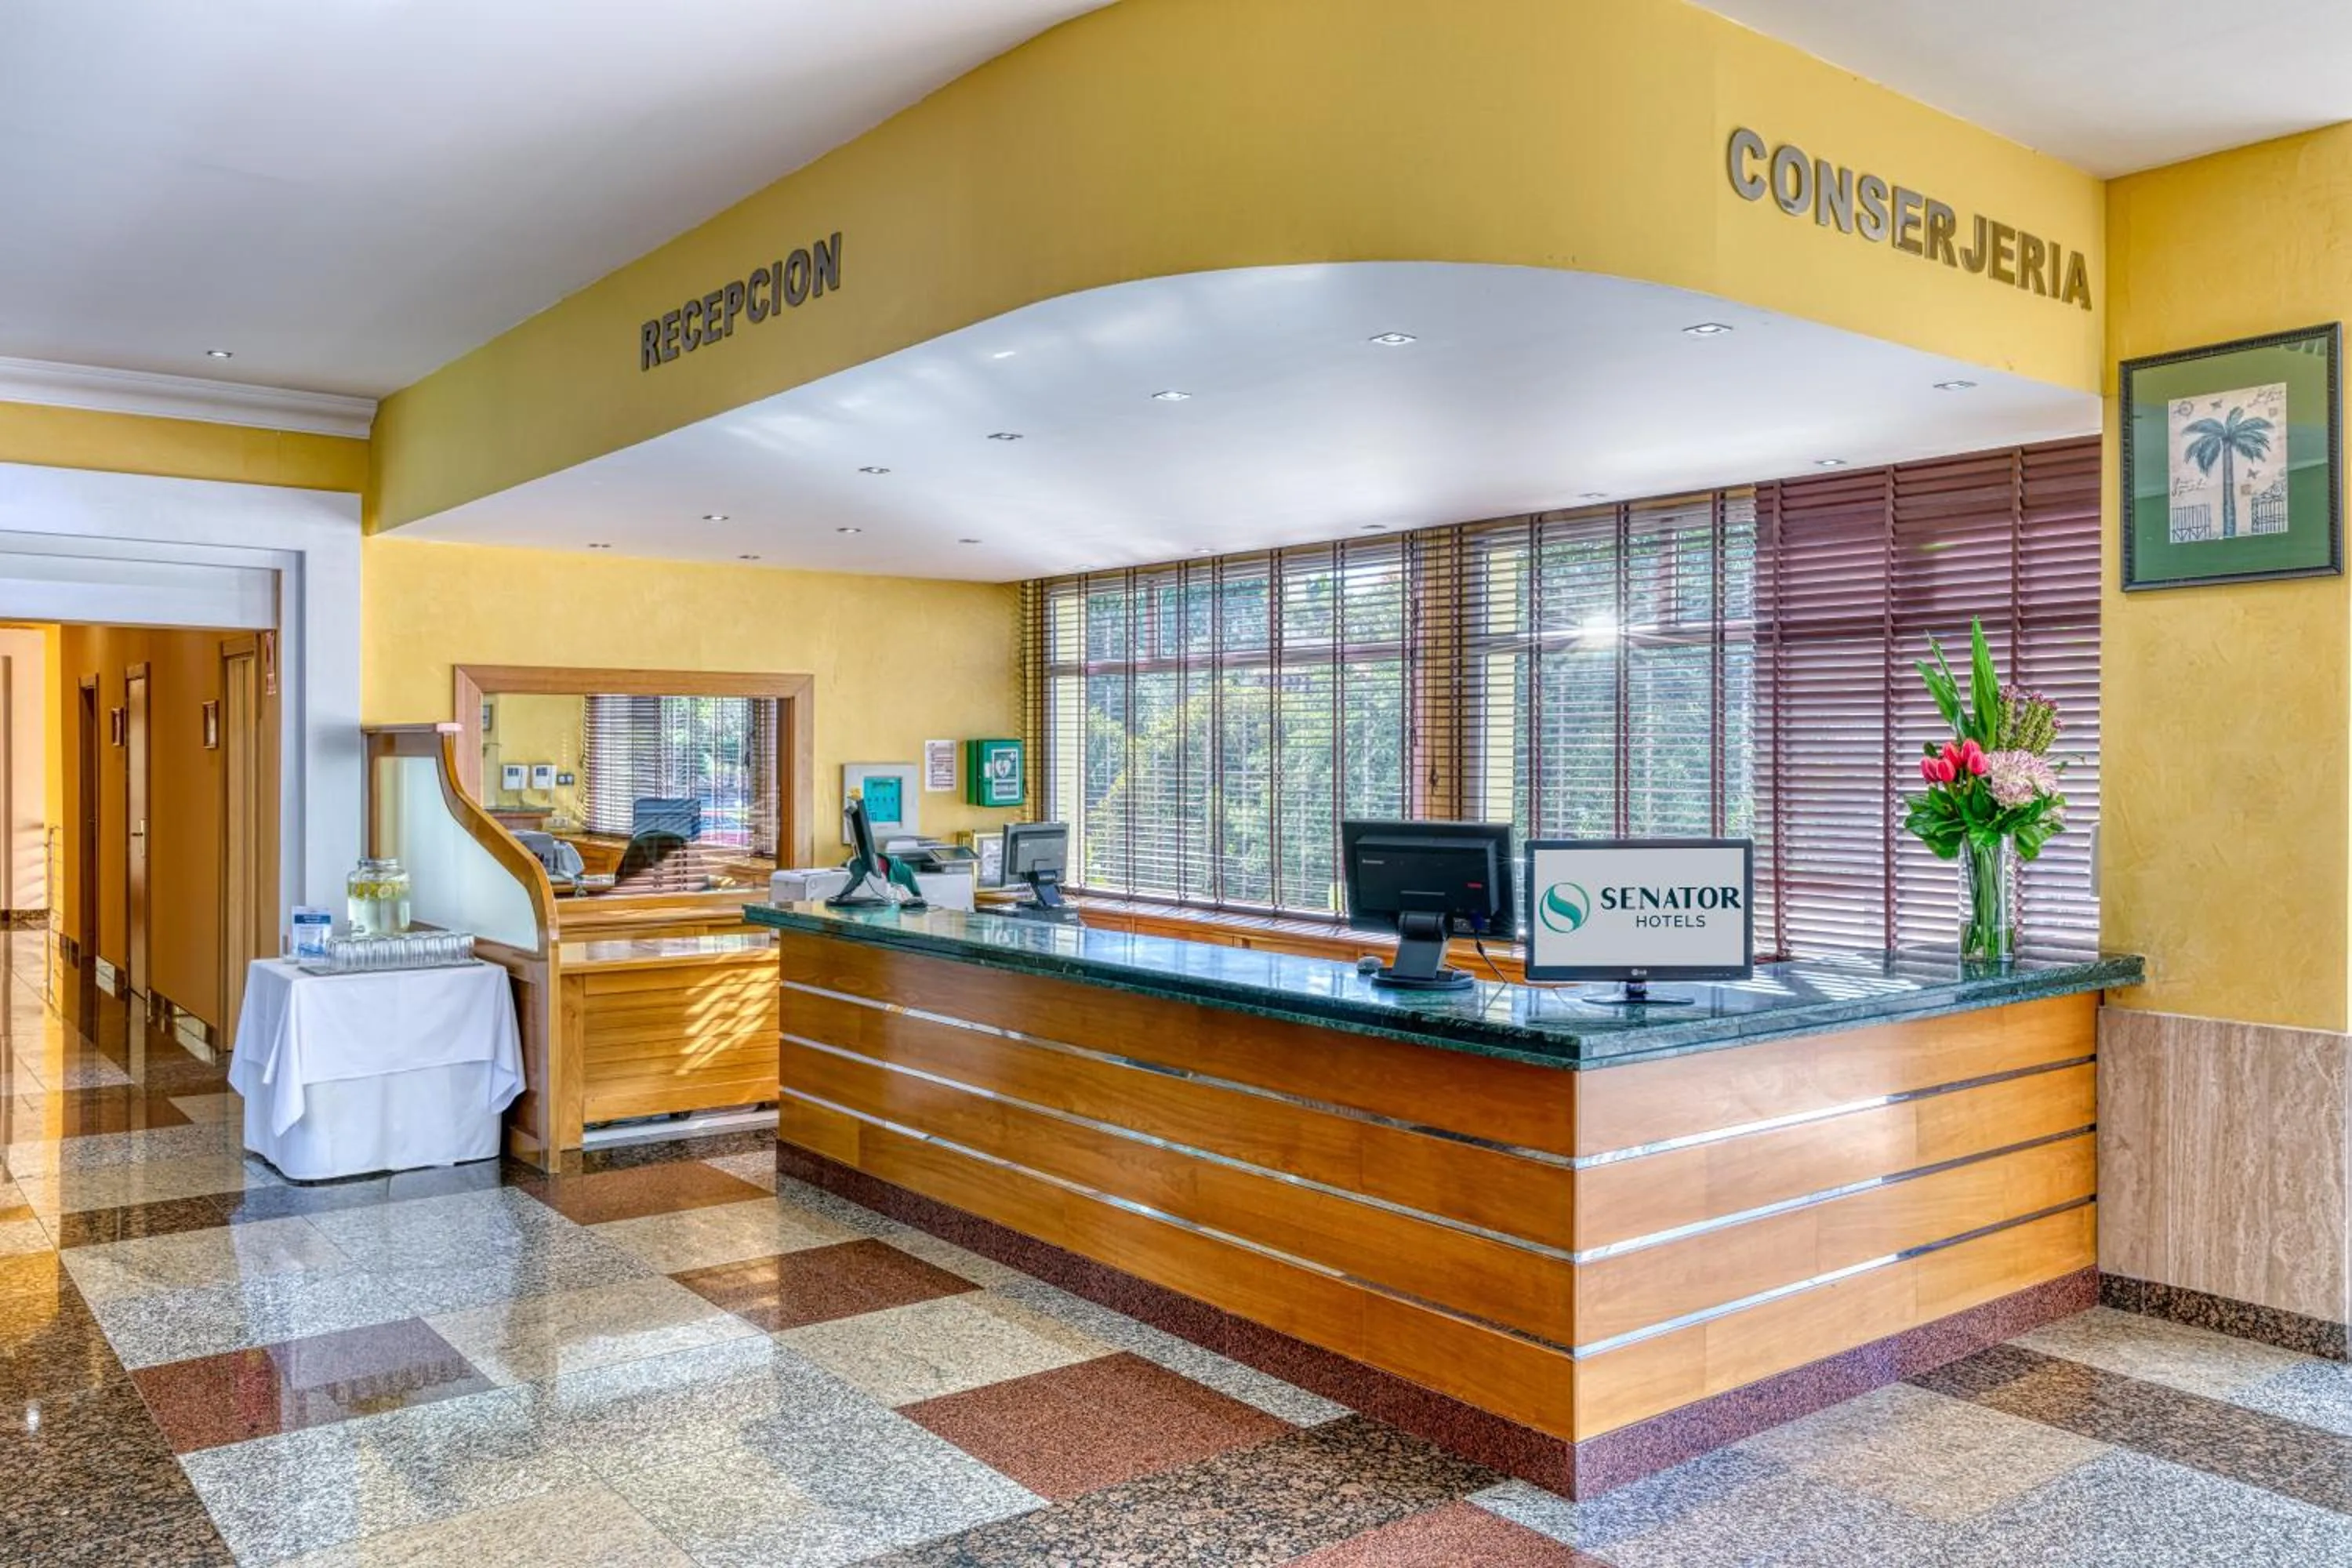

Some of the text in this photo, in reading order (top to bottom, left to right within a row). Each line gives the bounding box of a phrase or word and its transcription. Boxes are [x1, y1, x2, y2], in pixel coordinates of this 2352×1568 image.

[1727, 126, 2092, 311] CONSERJERIA
[641, 231, 843, 372] RECEPCION
[1600, 887, 1741, 909] SENATOR
[1635, 915, 1706, 927] HOTELS
